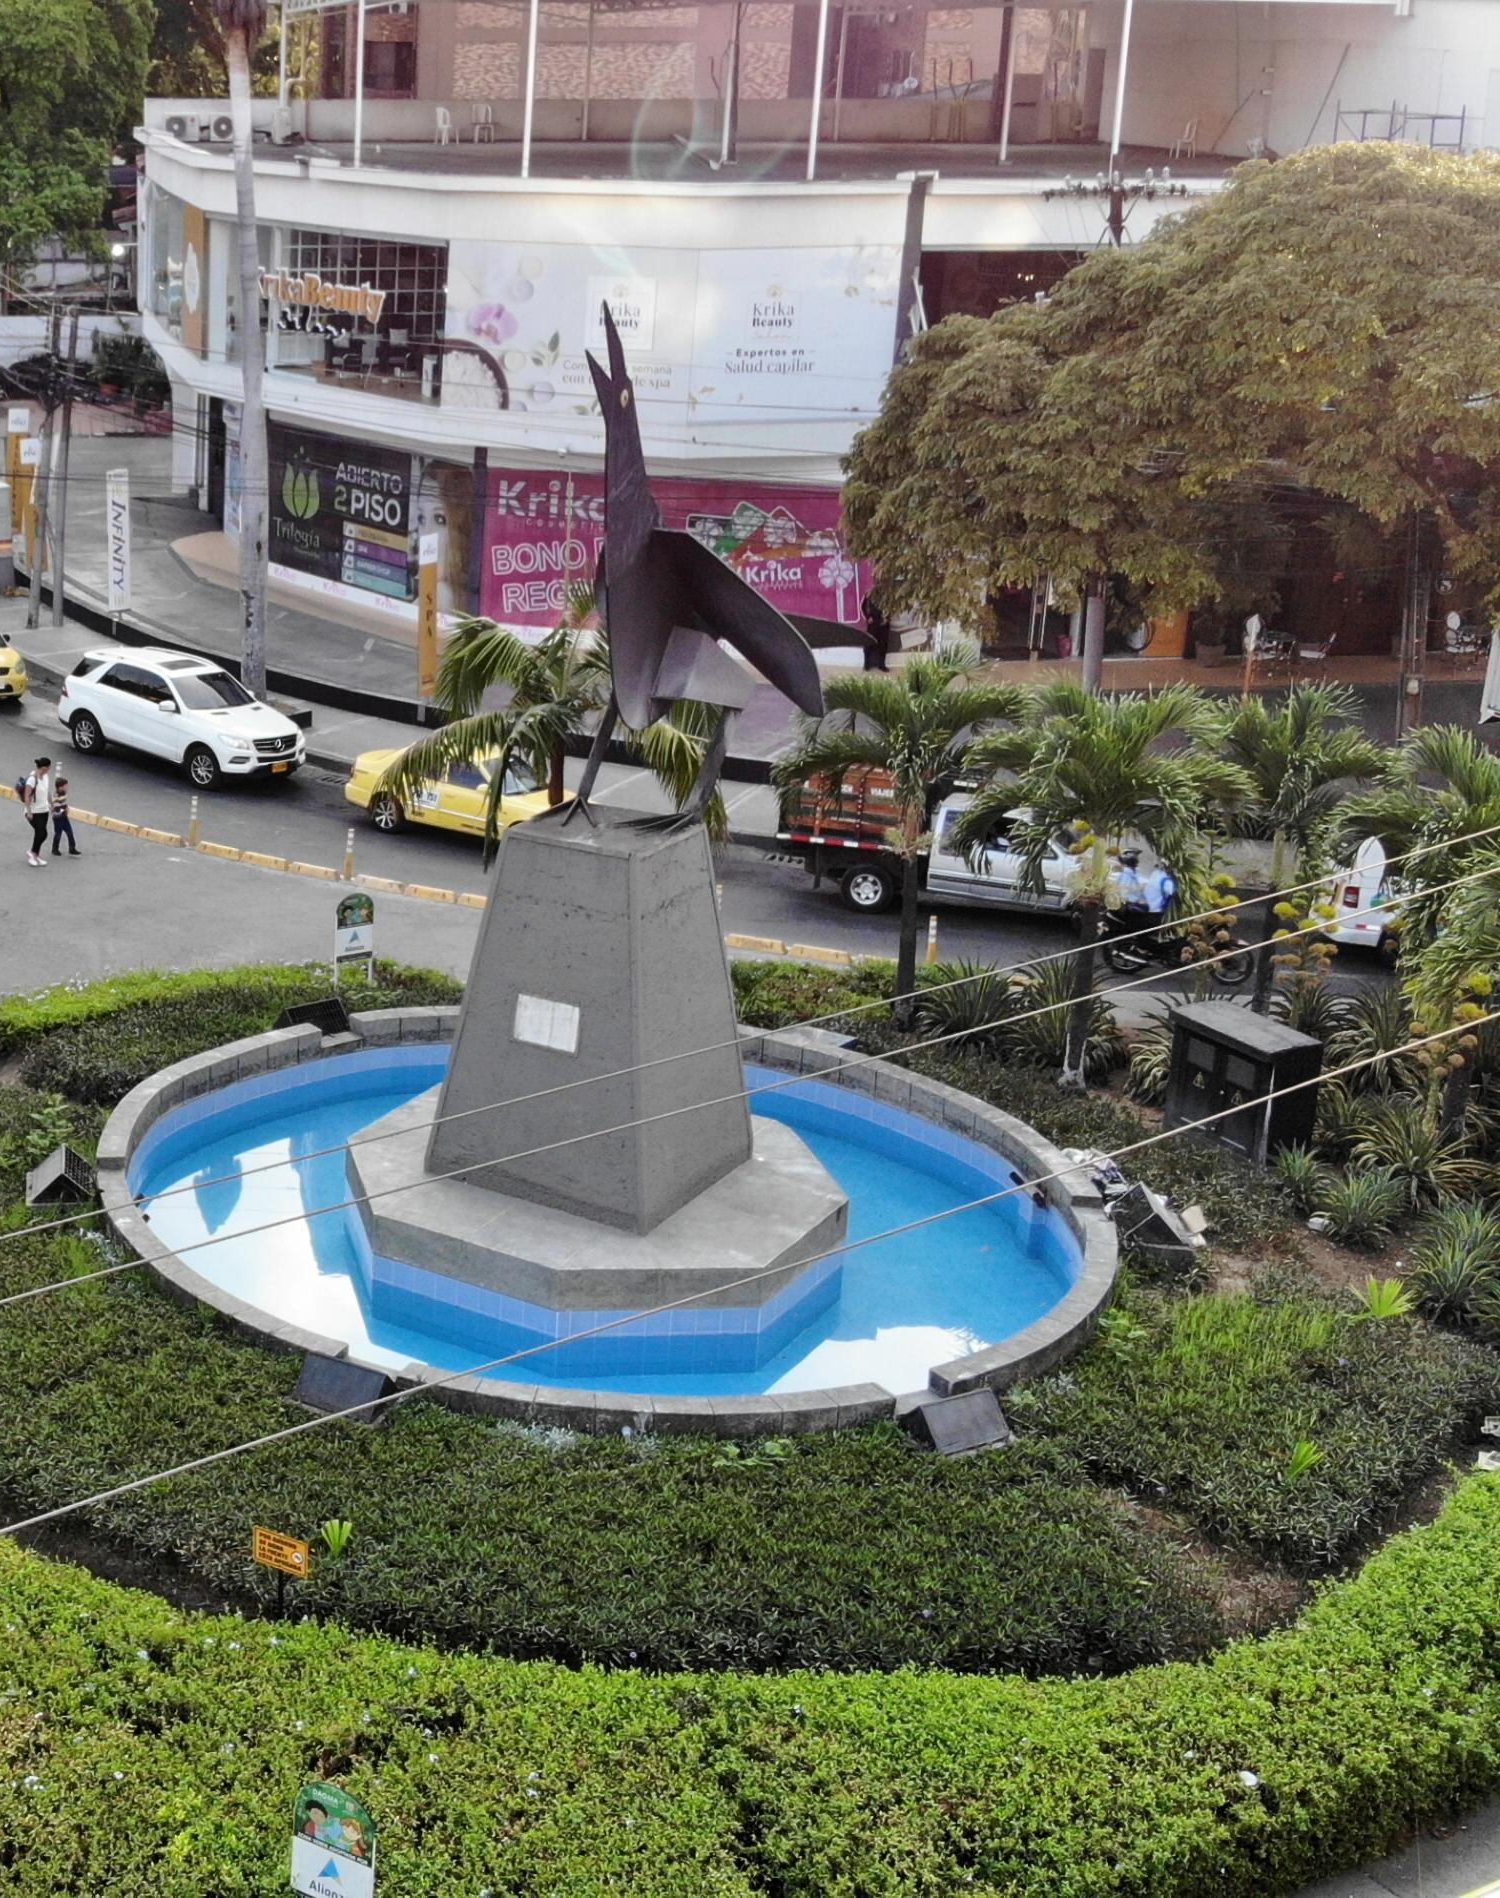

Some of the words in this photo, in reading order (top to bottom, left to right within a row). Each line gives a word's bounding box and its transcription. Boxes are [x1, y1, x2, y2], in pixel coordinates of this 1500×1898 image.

[752, 303, 794, 317] Krika
[752, 317, 793, 329] Beauty
[736, 349, 787, 358] Expertos
[724, 360, 764, 374] Salud
[767, 359, 816, 375] capilar
[335, 462, 403, 495] ABIERTO
[334, 484, 347, 512] 2
[350, 489, 401, 526] PISO
[111, 499, 126, 591] INFINITY
[491, 538, 587, 575] BONO
[746, 560, 804, 583] Krika
